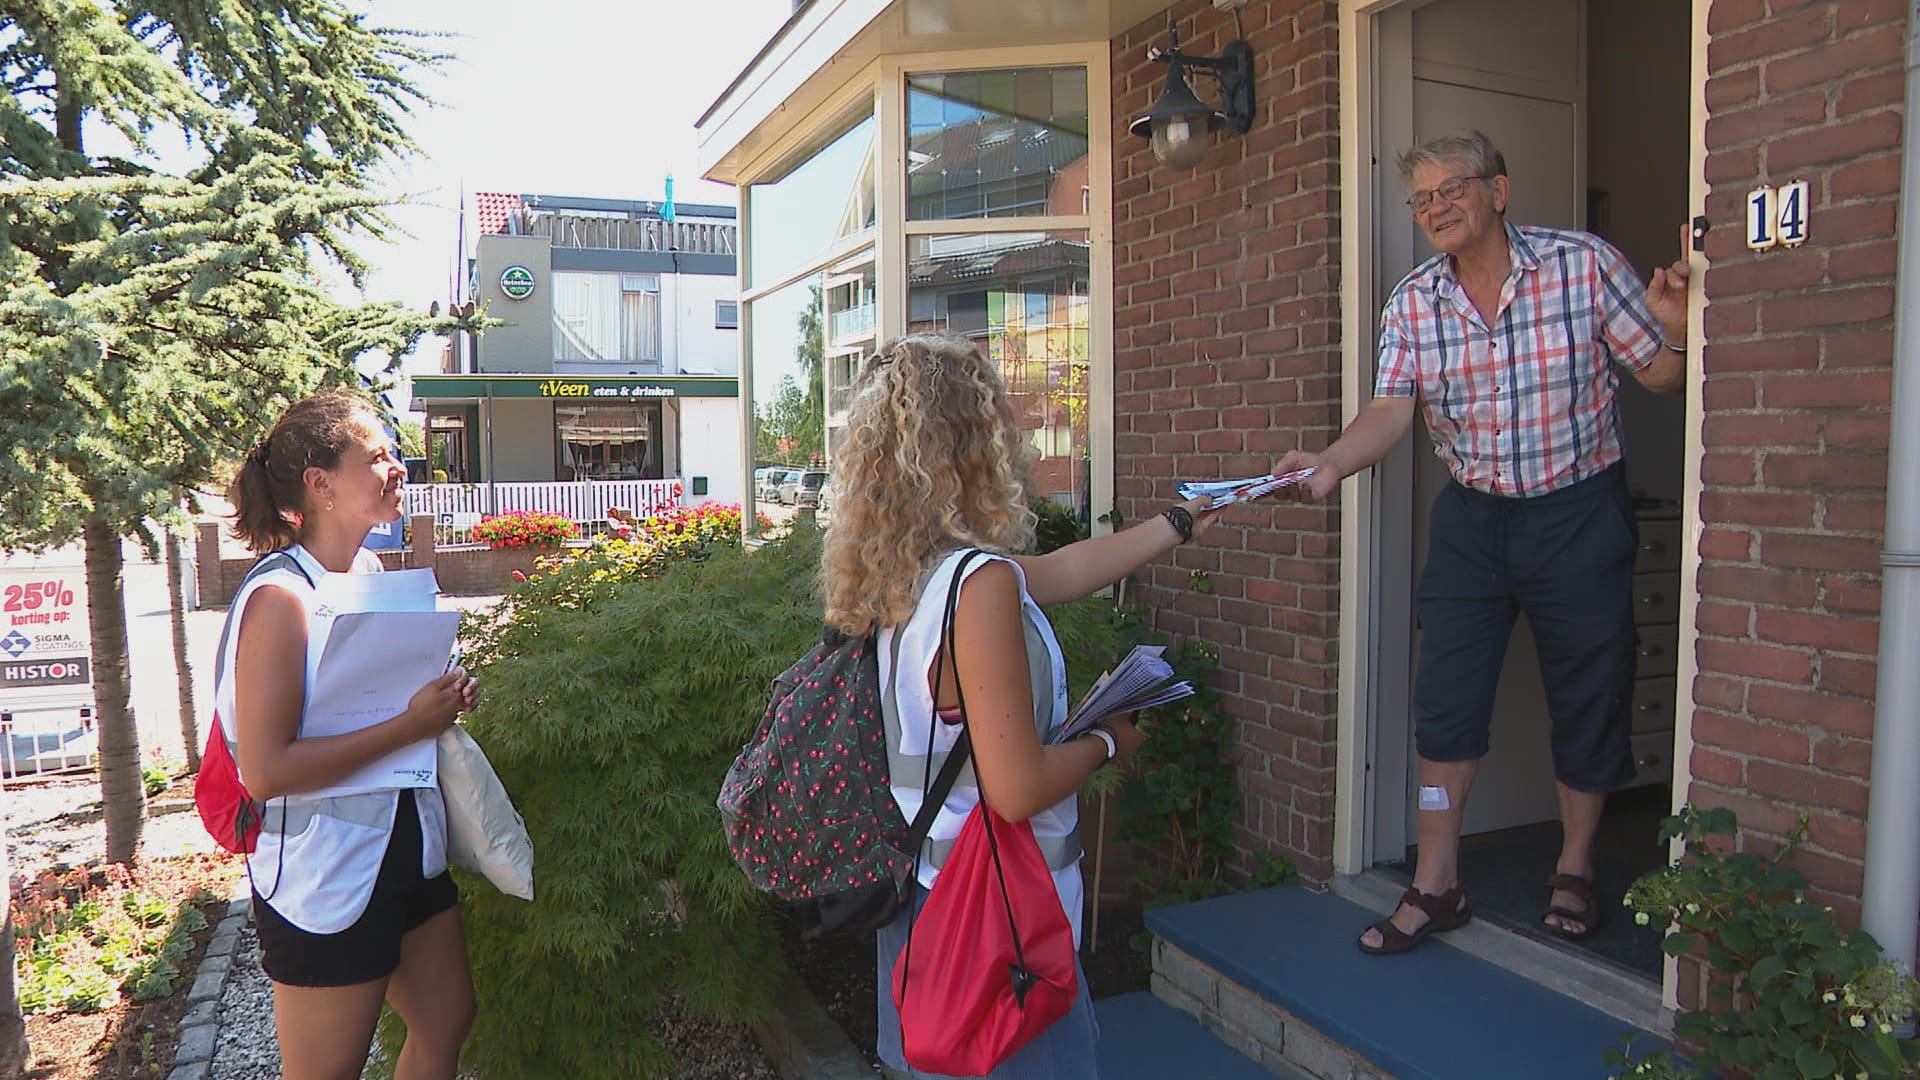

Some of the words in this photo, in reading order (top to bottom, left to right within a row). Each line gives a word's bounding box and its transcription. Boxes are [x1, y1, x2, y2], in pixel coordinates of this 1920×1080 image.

[1751, 187, 1804, 244] 14
[593, 387, 617, 396] eten
[619, 386, 630, 396] &
[631, 386, 675, 396] drinken
[3, 580, 74, 612] 25%
[11, 612, 50, 626] korting
[53, 611, 70, 623] op:
[34, 634, 71, 643] SIGMA
[35, 641, 85, 650] COATINGS
[5, 663, 80, 680] HISTOR
